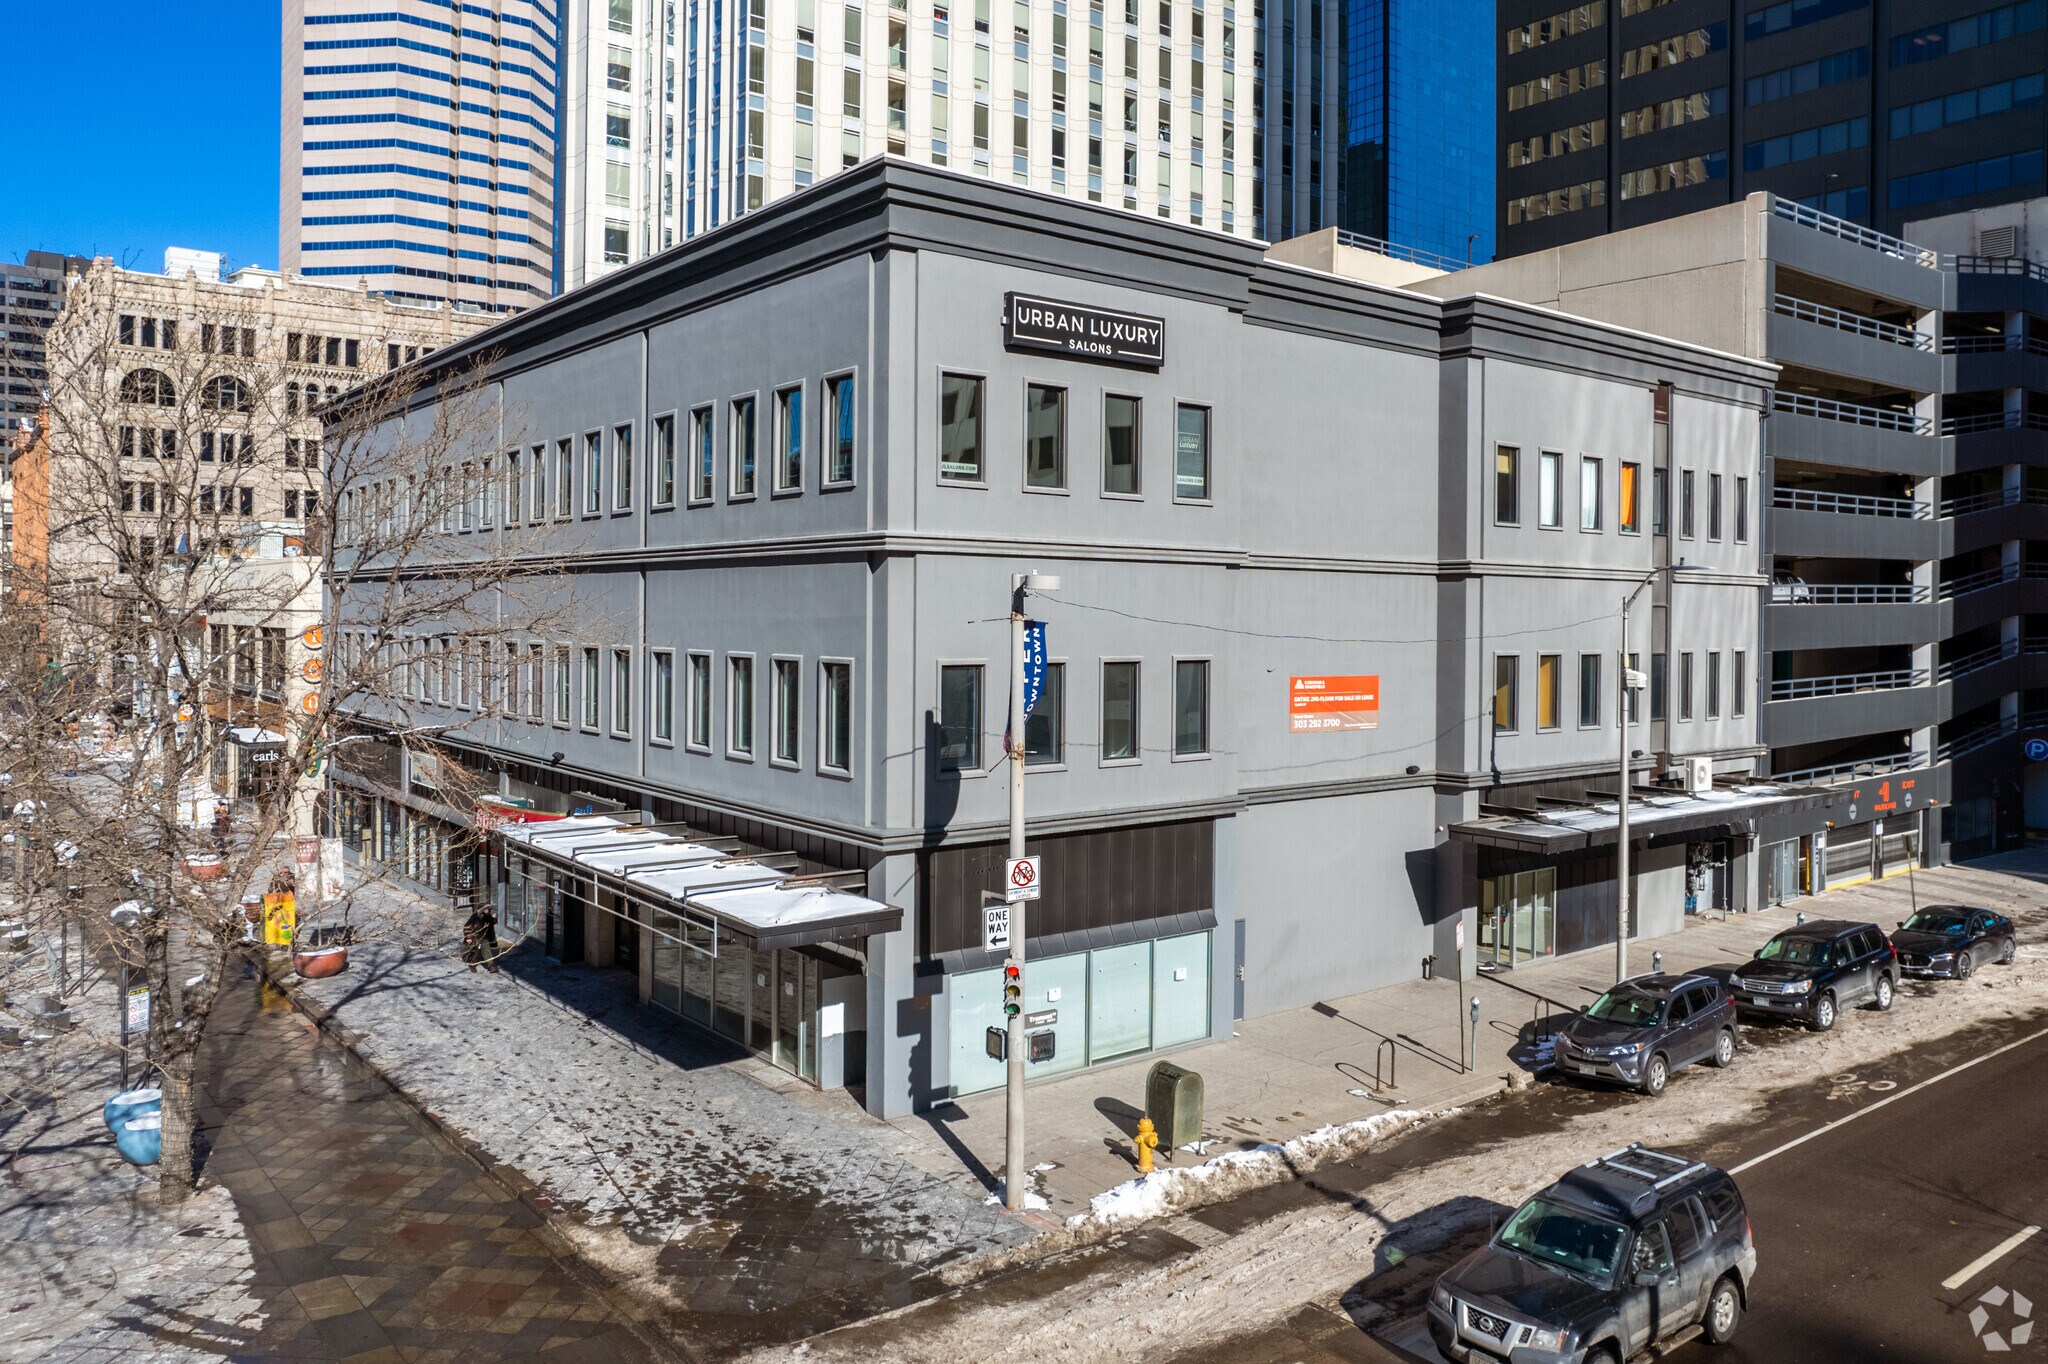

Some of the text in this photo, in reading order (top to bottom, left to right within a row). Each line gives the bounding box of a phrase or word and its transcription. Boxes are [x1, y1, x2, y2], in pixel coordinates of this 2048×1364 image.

[1018, 306, 1160, 345] URBAN LUXURY
[1069, 339, 1112, 355] SALONS
[1293, 720, 1308, 728] 303
[1308, 719, 1322, 728] 292
[1323, 718, 1340, 727] 3700
[252, 750, 279, 761] earls
[1902, 780, 1915, 789] EXIT
[1874, 801, 1897, 811] PARKING
[988, 910, 1008, 922] ONE
[988, 922, 1008, 934] WAY
